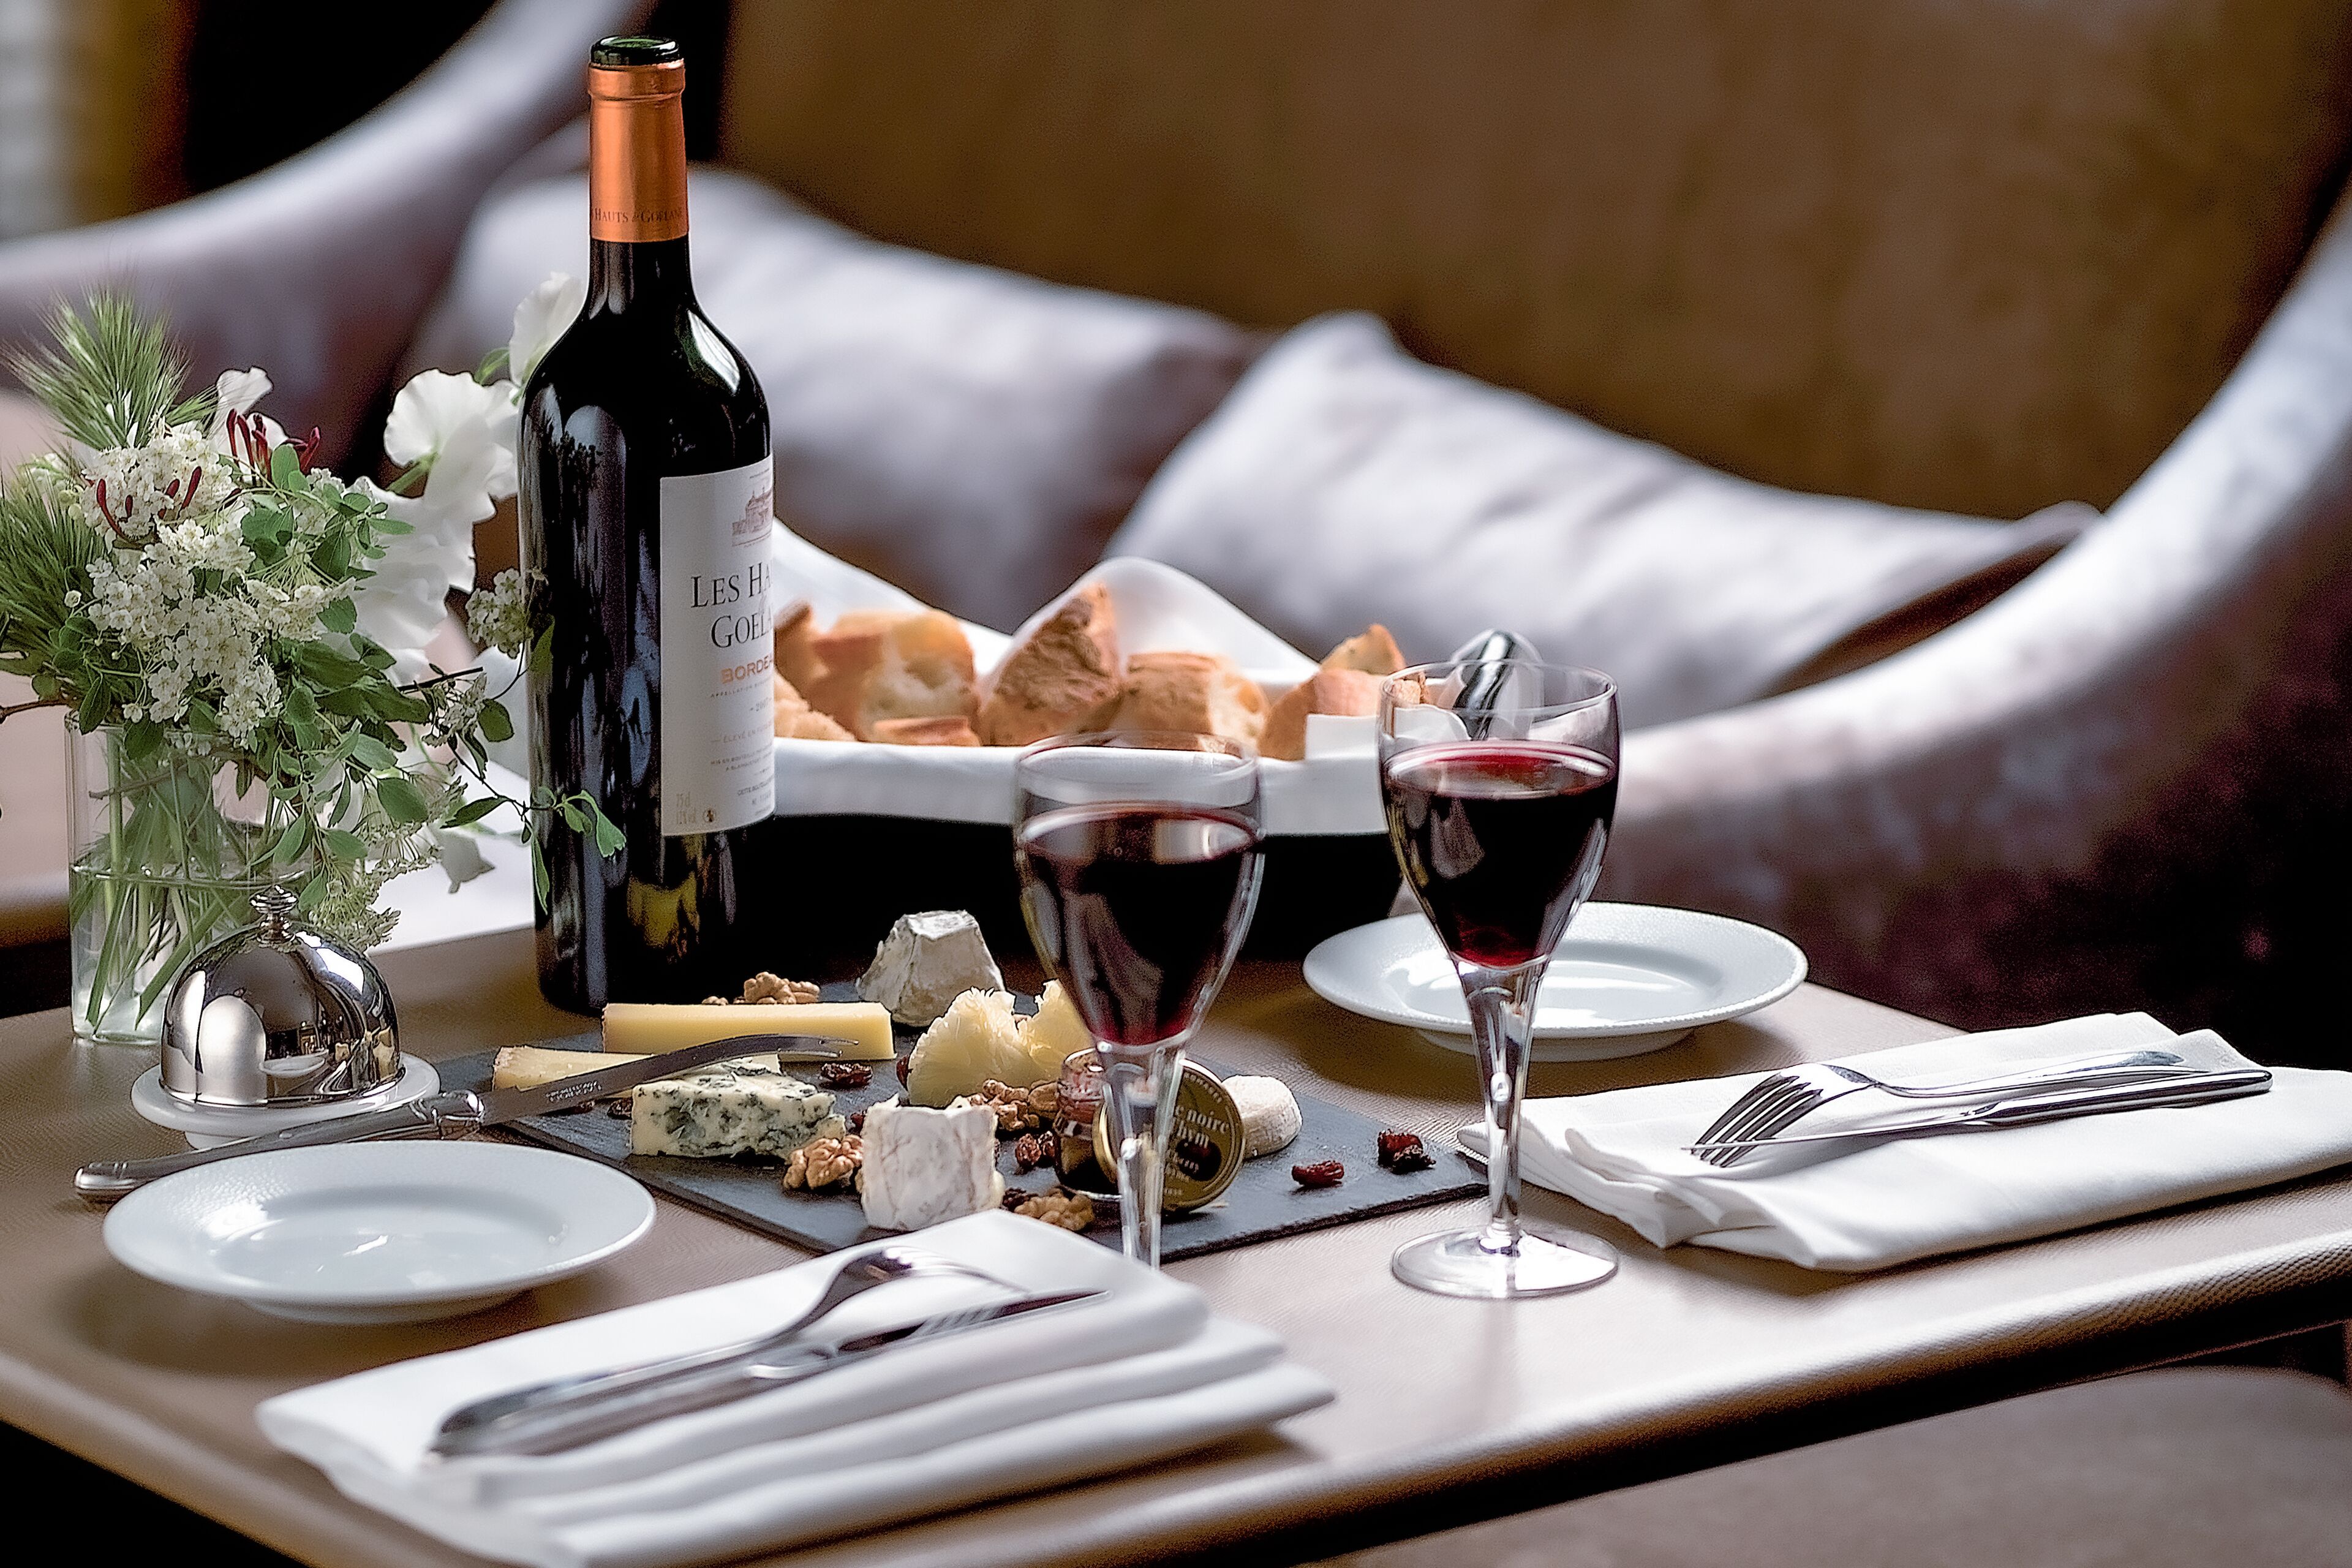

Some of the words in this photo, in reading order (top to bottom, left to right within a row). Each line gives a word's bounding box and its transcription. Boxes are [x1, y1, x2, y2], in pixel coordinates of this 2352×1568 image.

[690, 575, 740, 608] LES
[748, 562, 771, 598] HA
[1177, 1120, 1210, 1149] hym
